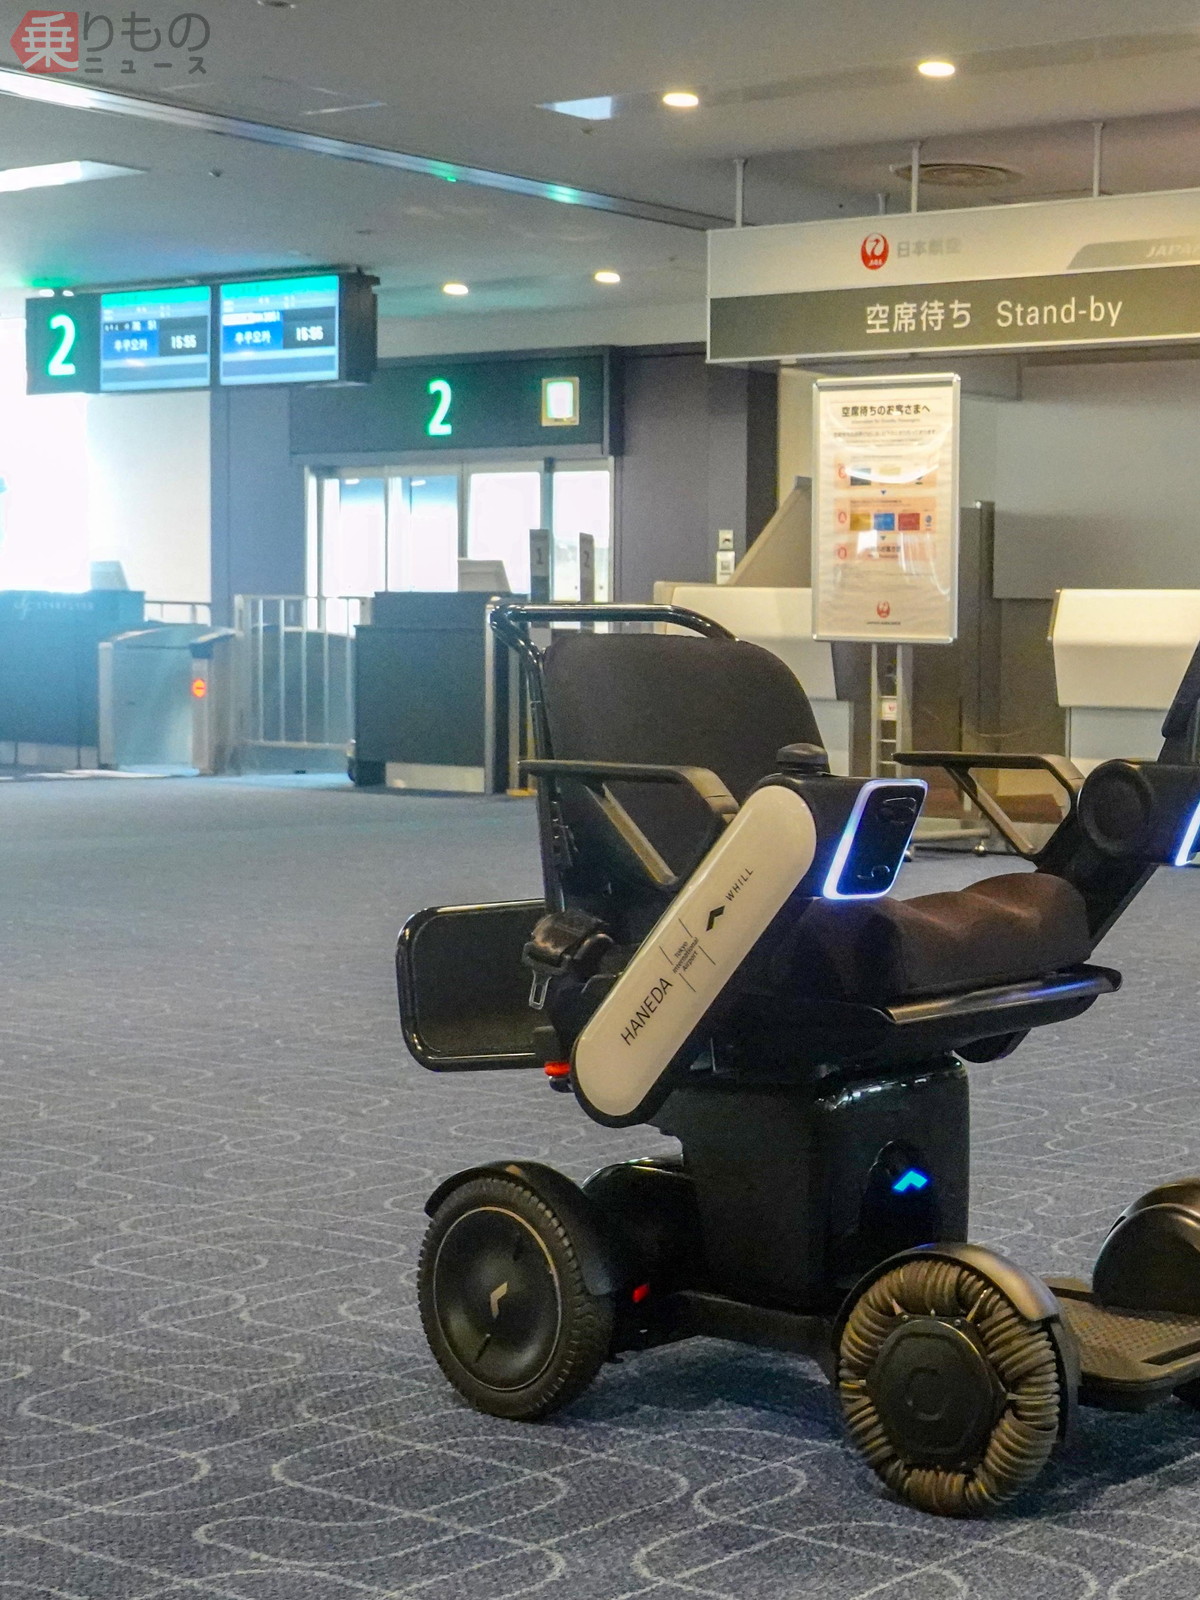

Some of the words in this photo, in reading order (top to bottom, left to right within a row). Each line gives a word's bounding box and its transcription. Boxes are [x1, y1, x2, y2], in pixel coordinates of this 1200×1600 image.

[866, 299, 972, 334] 空席待ち
[996, 295, 1123, 328] Stand-by
[48, 314, 77, 377] 2
[428, 379, 453, 436] 2
[725, 866, 754, 902] WHILL
[620, 977, 673, 1046] HANEDA
